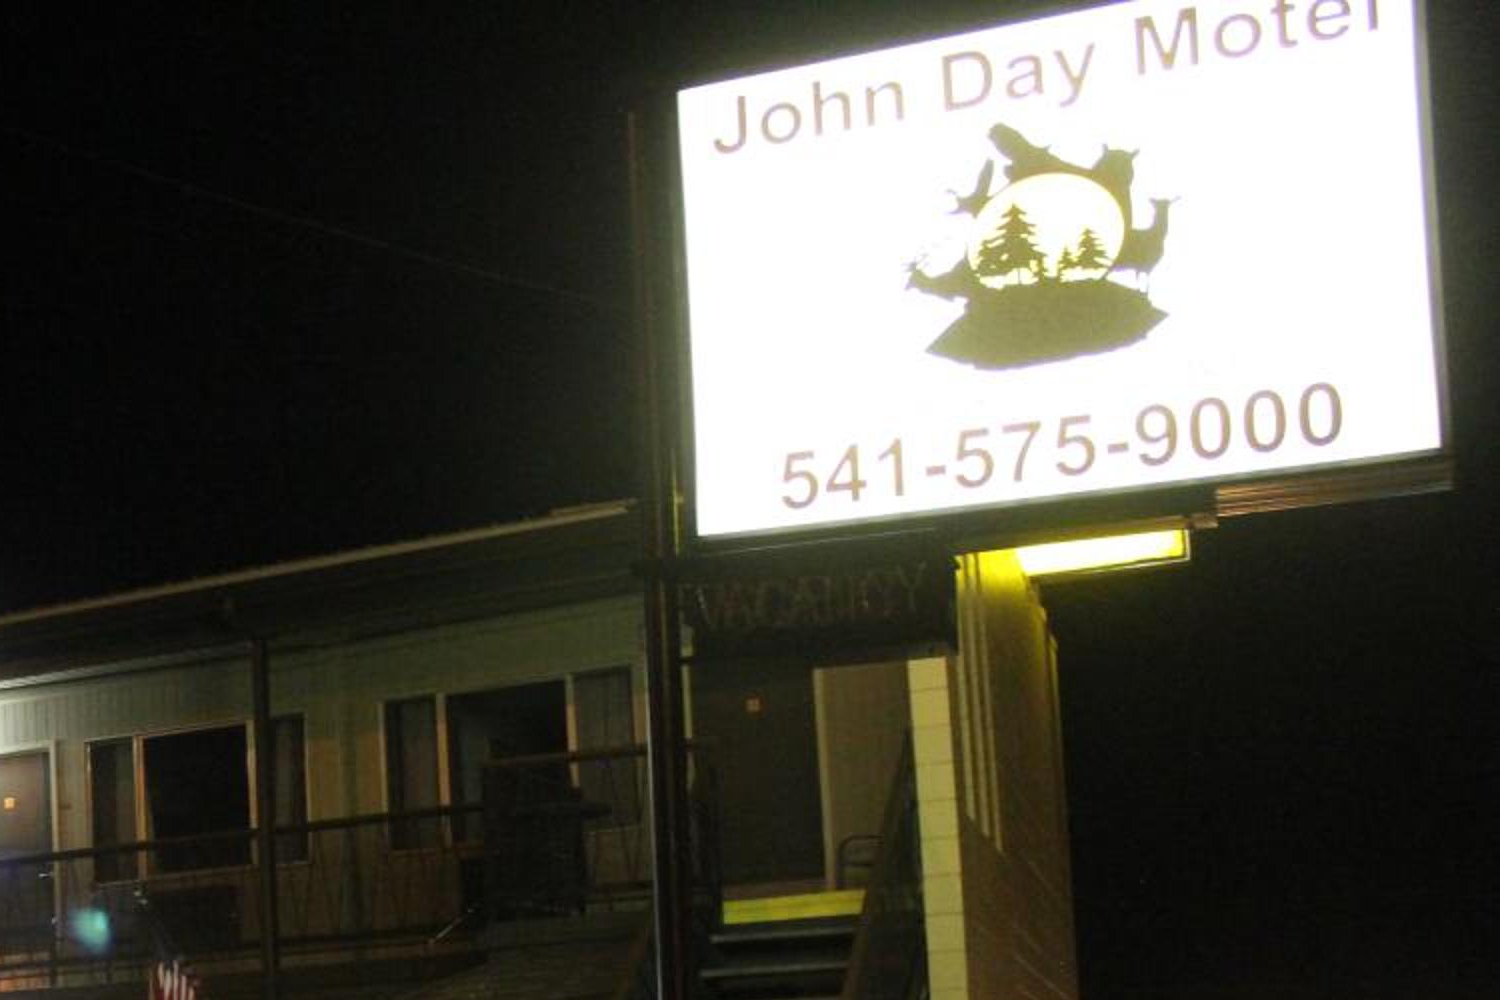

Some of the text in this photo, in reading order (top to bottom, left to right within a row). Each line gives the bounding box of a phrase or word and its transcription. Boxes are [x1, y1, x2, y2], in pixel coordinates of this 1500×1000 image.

[714, 81, 904, 154] John
[942, 43, 1095, 112] Day
[781, 381, 1344, 510] 541-575-9000
